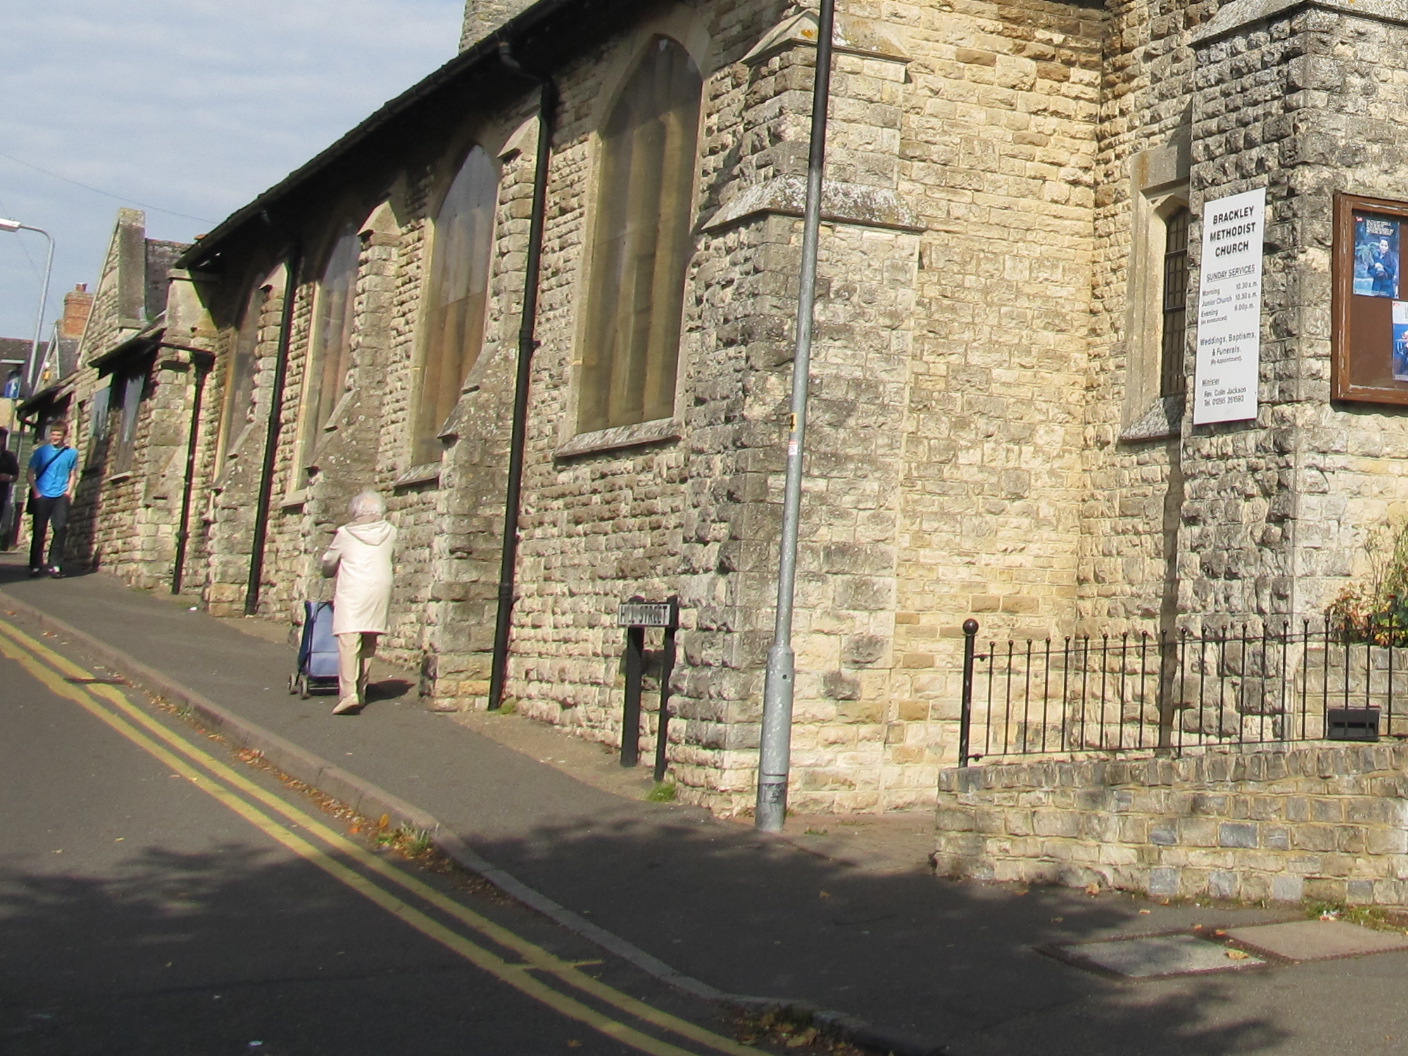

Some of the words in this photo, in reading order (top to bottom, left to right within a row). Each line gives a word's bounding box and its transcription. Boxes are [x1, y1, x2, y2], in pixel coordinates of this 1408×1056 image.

[1213, 205, 1255, 225] BRACKLEY
[1209, 222, 1256, 242] METHODIST
[1215, 240, 1249, 257] CHURCH
[1206, 270, 1228, 282] SUNDAY
[1228, 264, 1255, 278] SERVICES
[1202, 299, 1216, 307] Junior
[1216, 296, 1232, 304] Church
[1201, 309, 1219, 318] Evening
[1200, 336, 1227, 346] Weddings,
[1228, 331, 1256, 342] Baptisms,
[1214, 388, 1226, 397] Colin
[1227, 386, 1247, 395] Jackson
[639, 605, 668, 624] STREET
